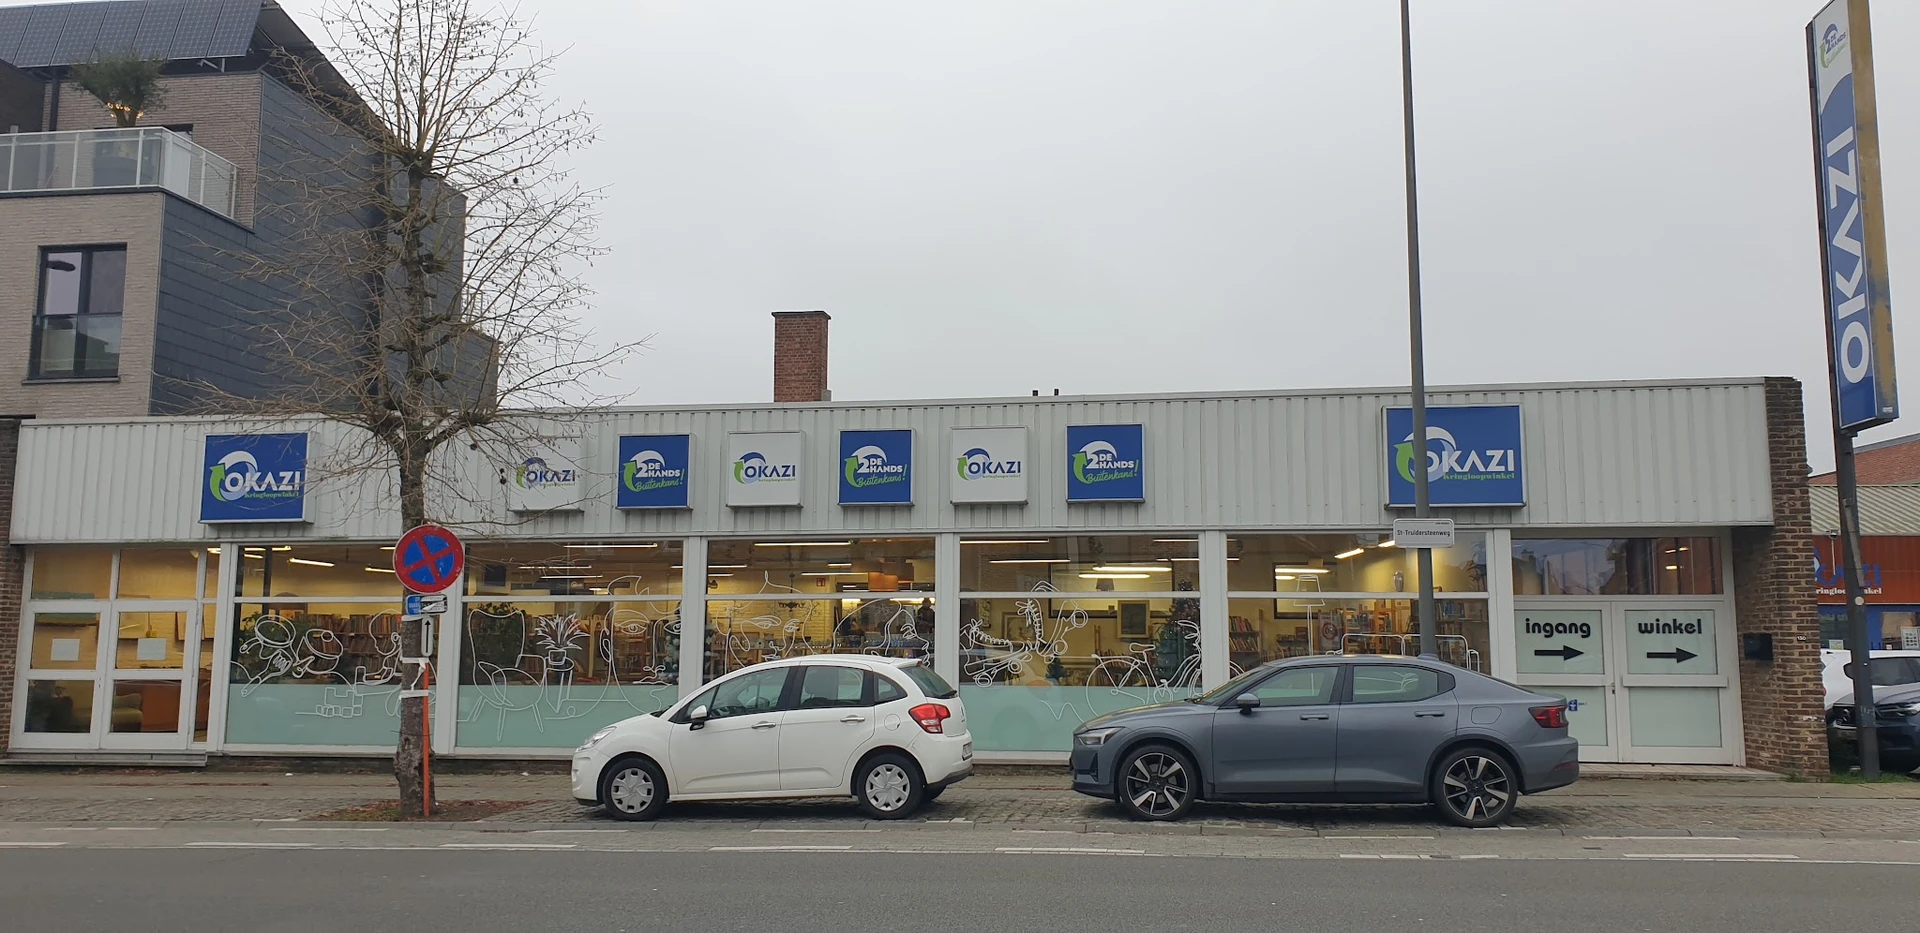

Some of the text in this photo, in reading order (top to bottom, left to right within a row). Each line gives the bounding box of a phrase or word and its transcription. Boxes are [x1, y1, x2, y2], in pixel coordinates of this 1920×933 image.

[1826, 126, 1870, 384] OKAZI
[857, 457, 882, 473] 2 DE
[967, 461, 1021, 474] OKAZI
[1086, 452, 1112, 469] 2 DE
[1099, 460, 1135, 469] HANDS
[526, 469, 576, 483] OKAZI
[636, 461, 660, 478] 2 DE
[648, 469, 681, 478] HANDS
[743, 465, 796, 478] OKAZI
[870, 465, 903, 473] HANDS
[224, 471, 300, 493] OKAZI
[1525, 617, 1703, 639] ingang winkel
